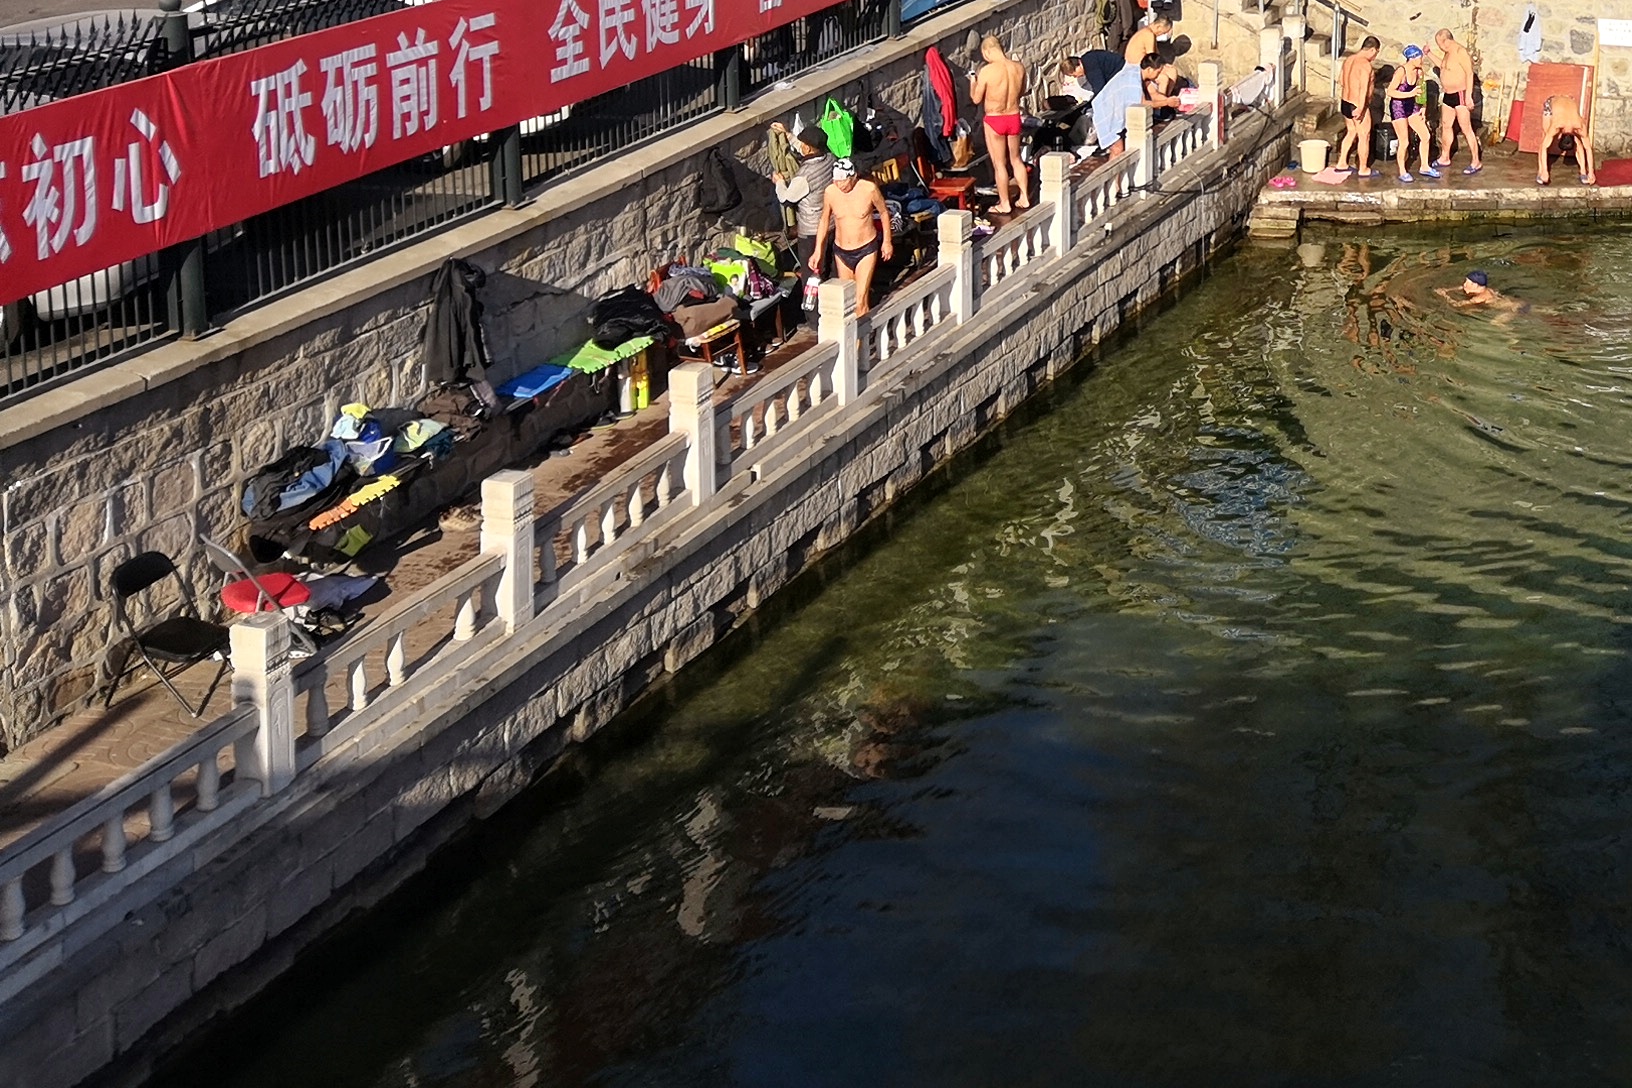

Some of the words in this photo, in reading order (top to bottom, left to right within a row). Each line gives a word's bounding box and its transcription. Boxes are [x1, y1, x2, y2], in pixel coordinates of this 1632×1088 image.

[0, 108, 182, 264] 初心
[249, 11, 500, 179] 砥砺前行
